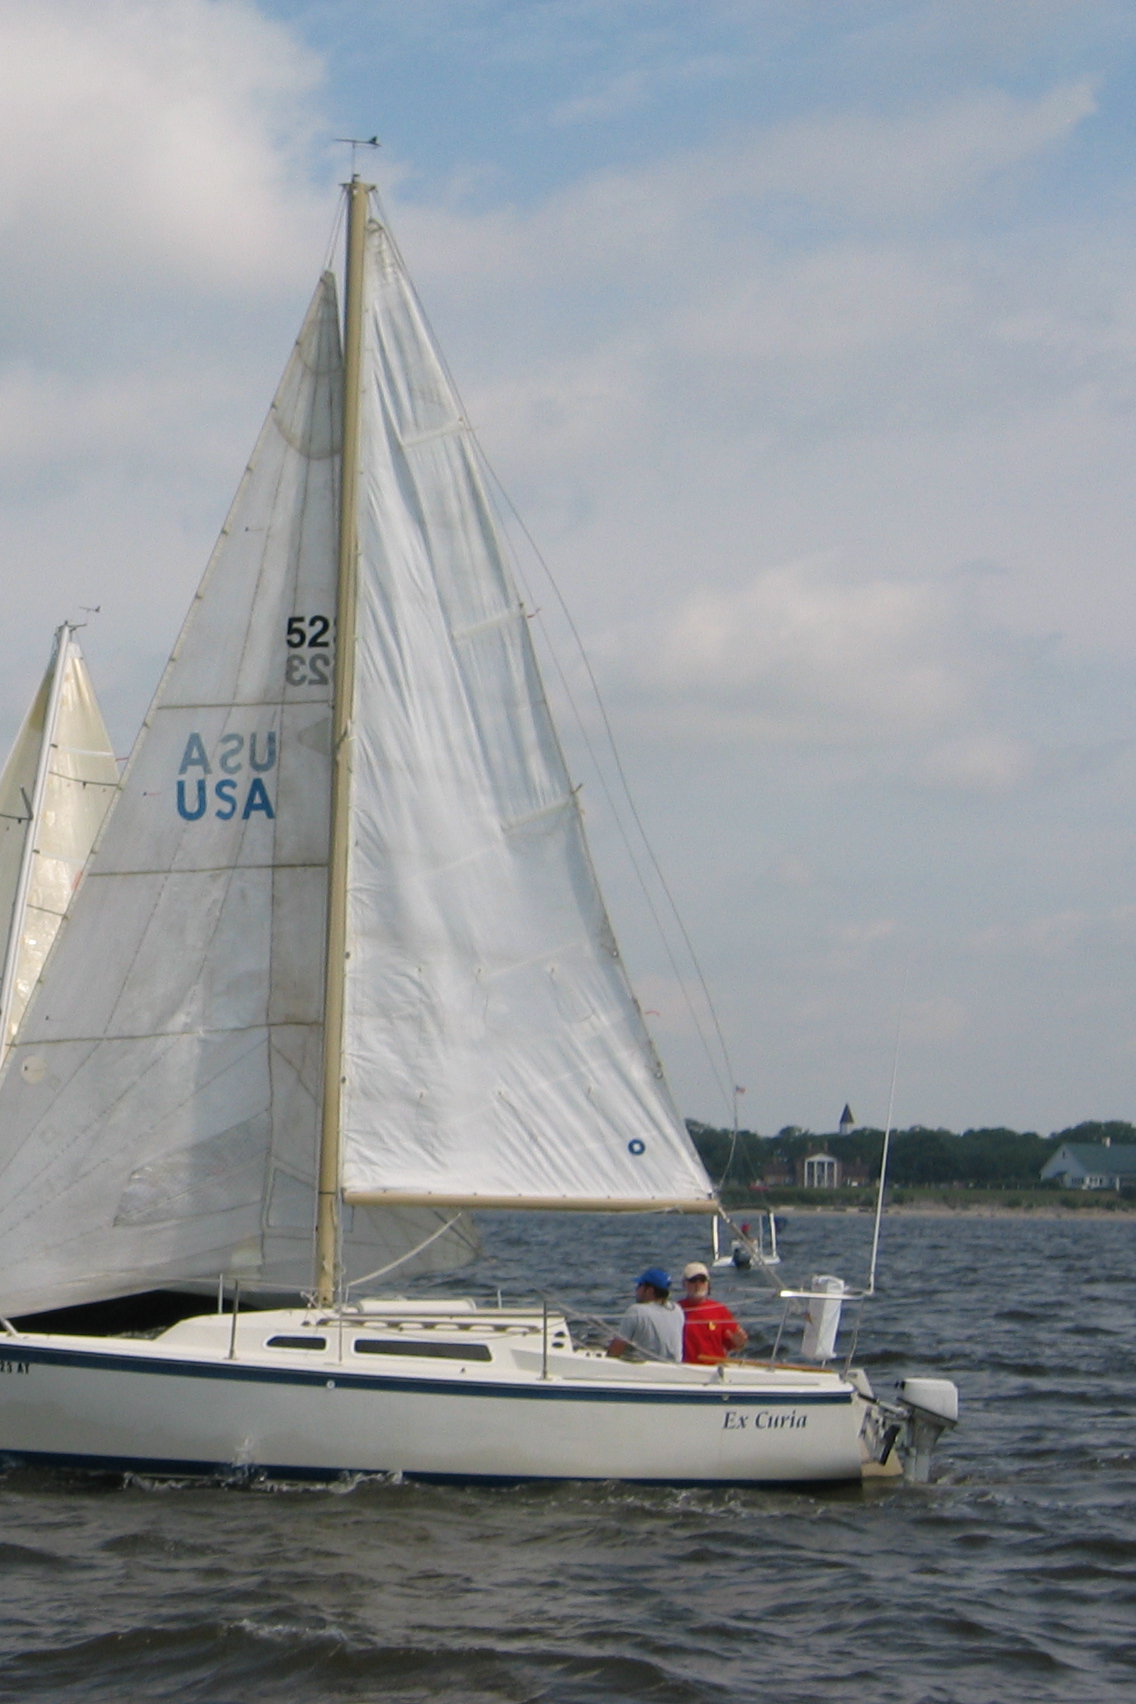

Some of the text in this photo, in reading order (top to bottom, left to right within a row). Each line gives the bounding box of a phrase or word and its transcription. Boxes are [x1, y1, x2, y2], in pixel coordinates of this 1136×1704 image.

[285, 614, 336, 648] 52
[176, 777, 275, 821] USA
[723, 1409, 808, 1429] Ex Curia
